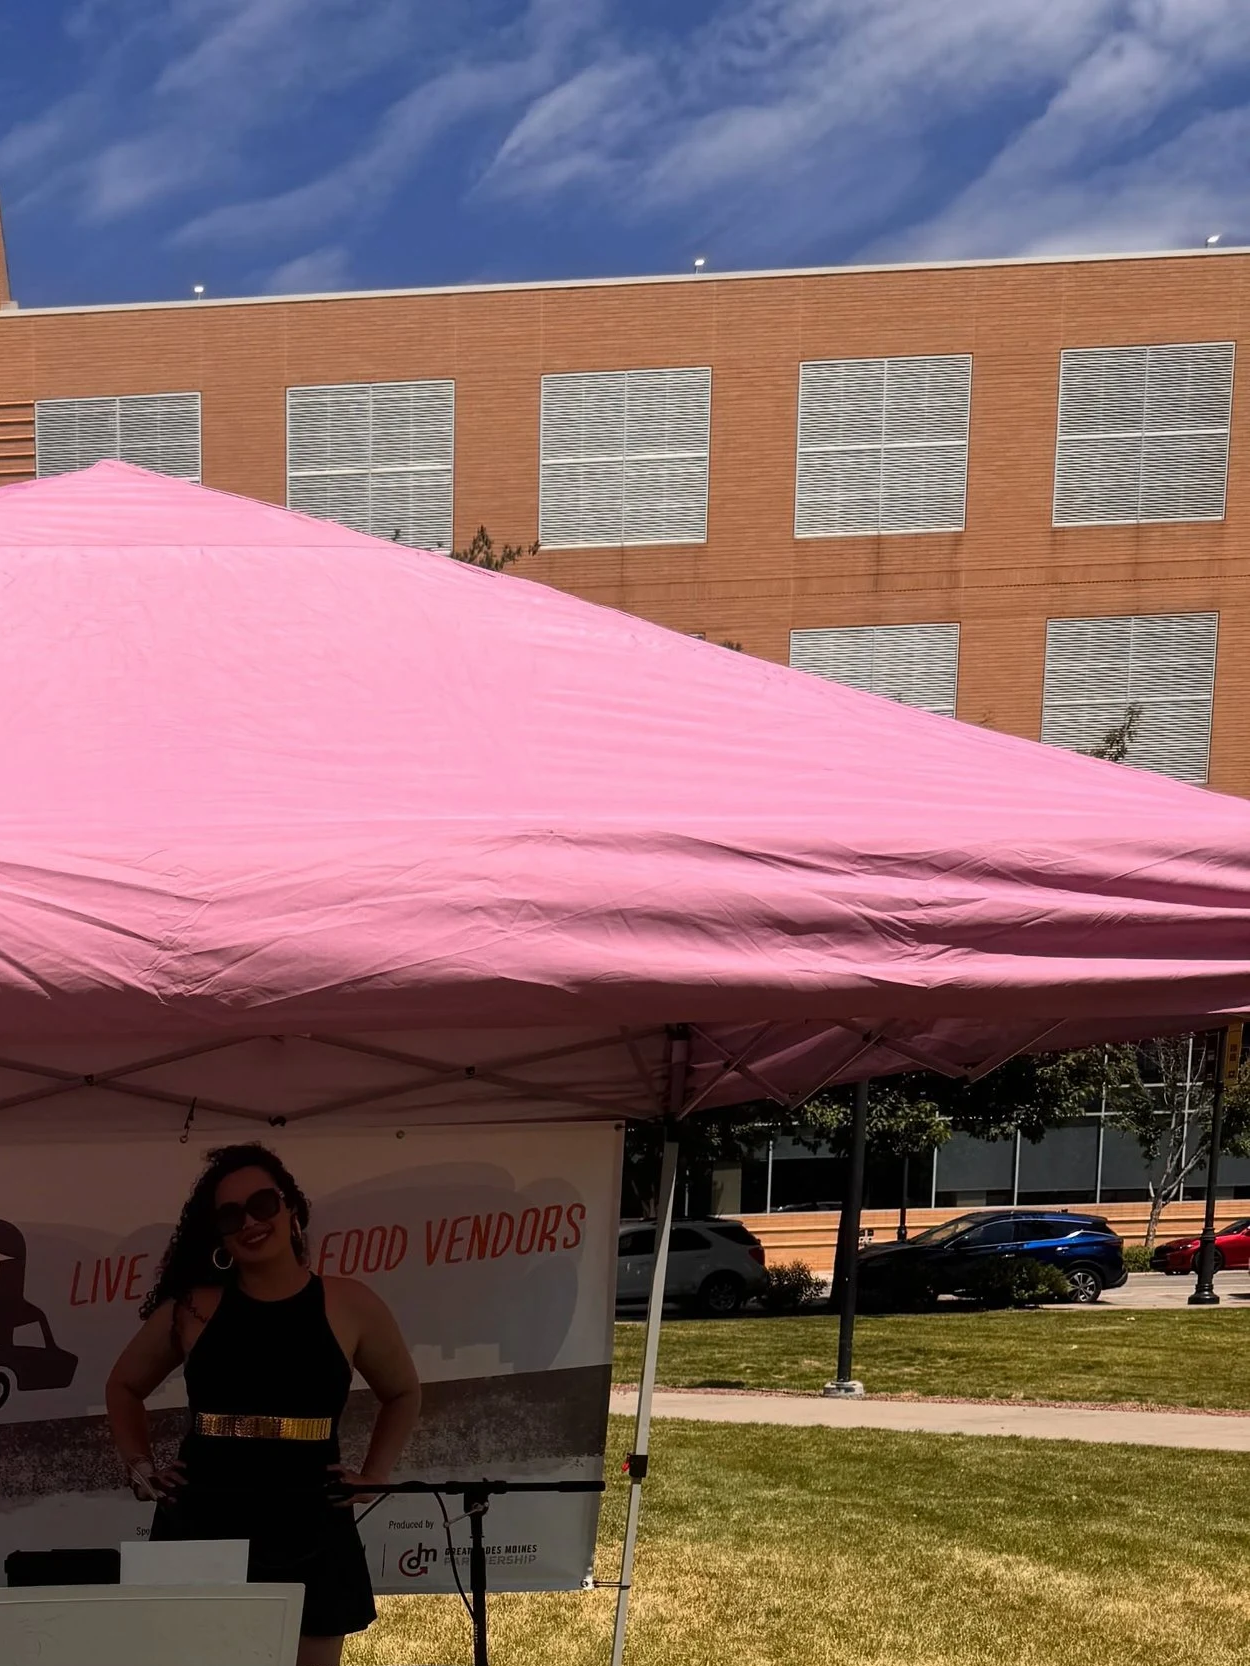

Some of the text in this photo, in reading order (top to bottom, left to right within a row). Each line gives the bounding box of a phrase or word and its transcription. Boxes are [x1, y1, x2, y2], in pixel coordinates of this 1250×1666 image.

[69, 1202, 587, 1307] LIVE FOOD VENDORS
[388, 1519, 434, 1531] Produced by
[485, 1545, 502, 1555] DES
[505, 1544, 538, 1554] MOINES
[444, 1554, 537, 1566] PARERSHIP
